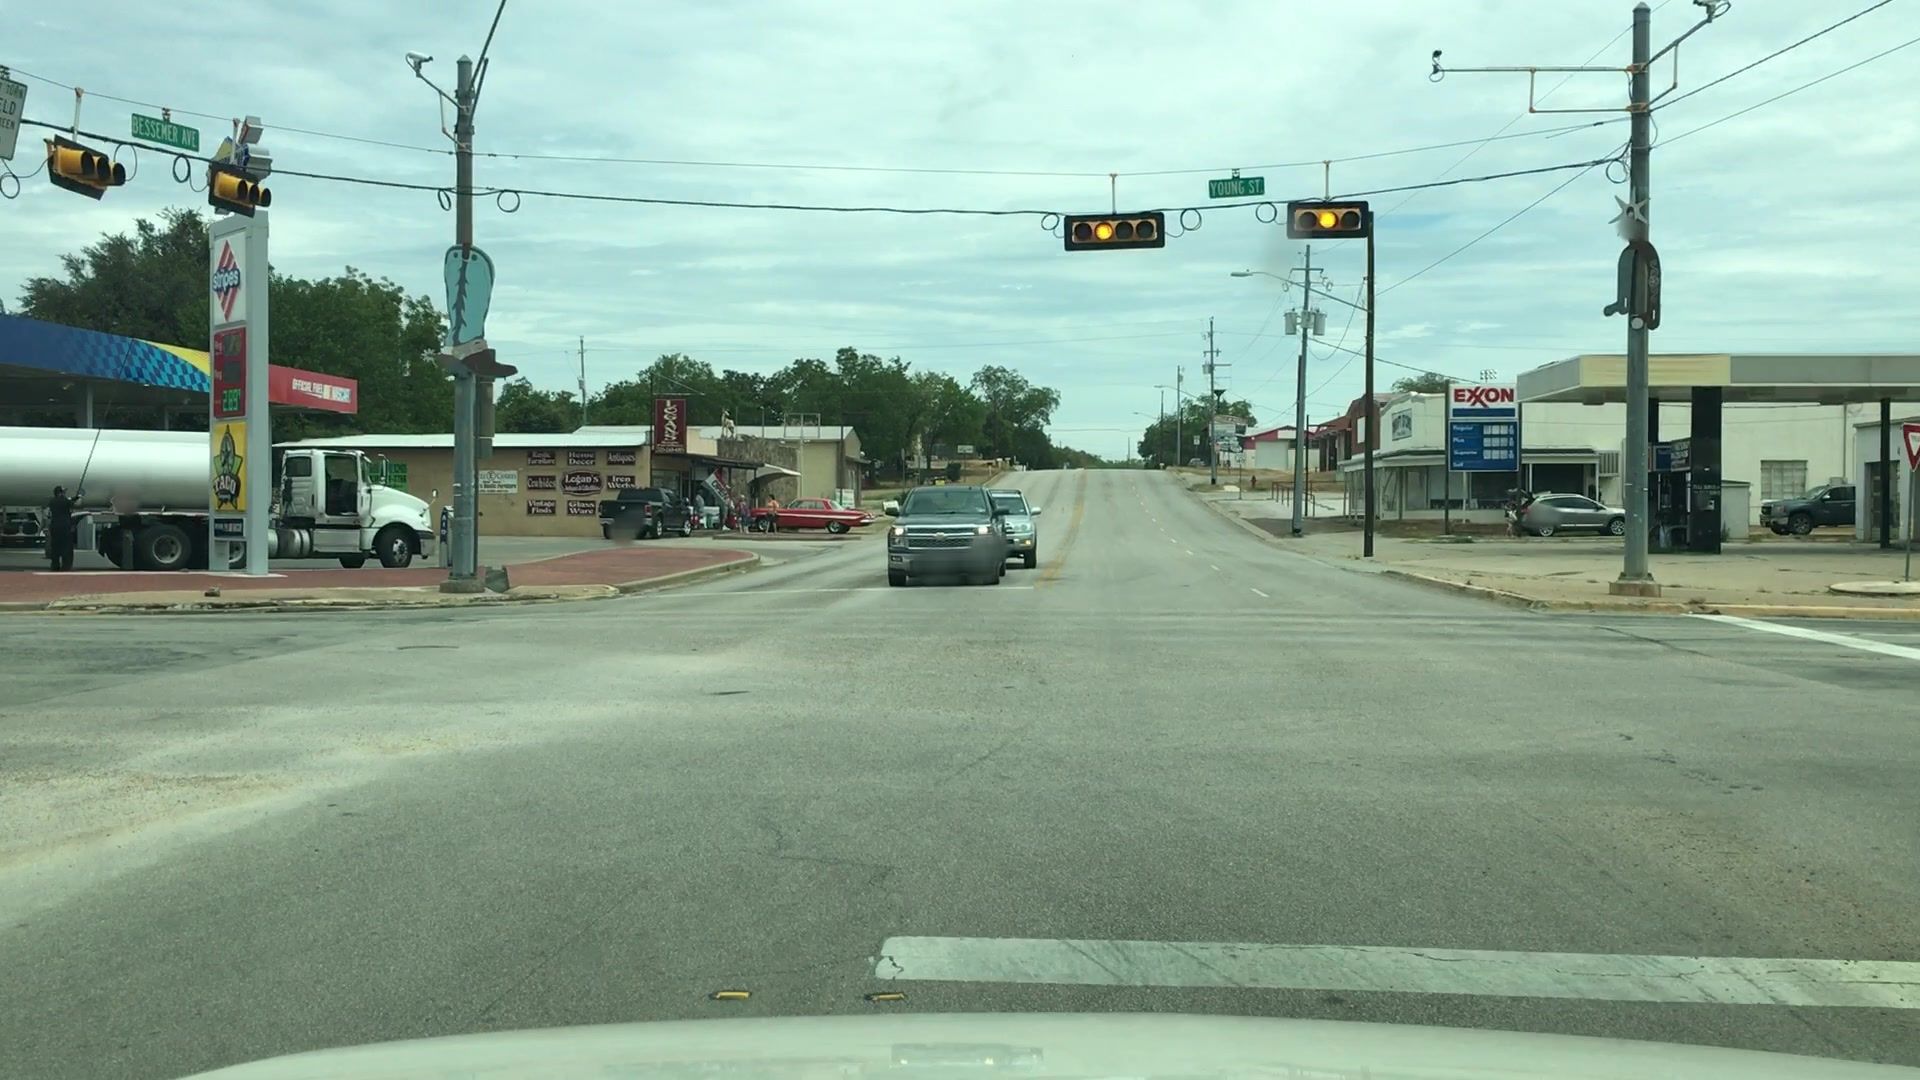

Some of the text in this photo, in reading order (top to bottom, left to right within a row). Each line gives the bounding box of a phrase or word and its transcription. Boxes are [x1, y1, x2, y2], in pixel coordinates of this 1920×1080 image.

[132, 116, 197, 147] BESSEMER AVE
[1210, 180, 1245, 197] YOUNG
[1454, 387, 1514, 408] EXXON
[608, 452, 636, 465] Antiques
[215, 475, 237, 495] TACO
[565, 474, 599, 486] Logan's
[529, 500, 555, 509] Vintage
